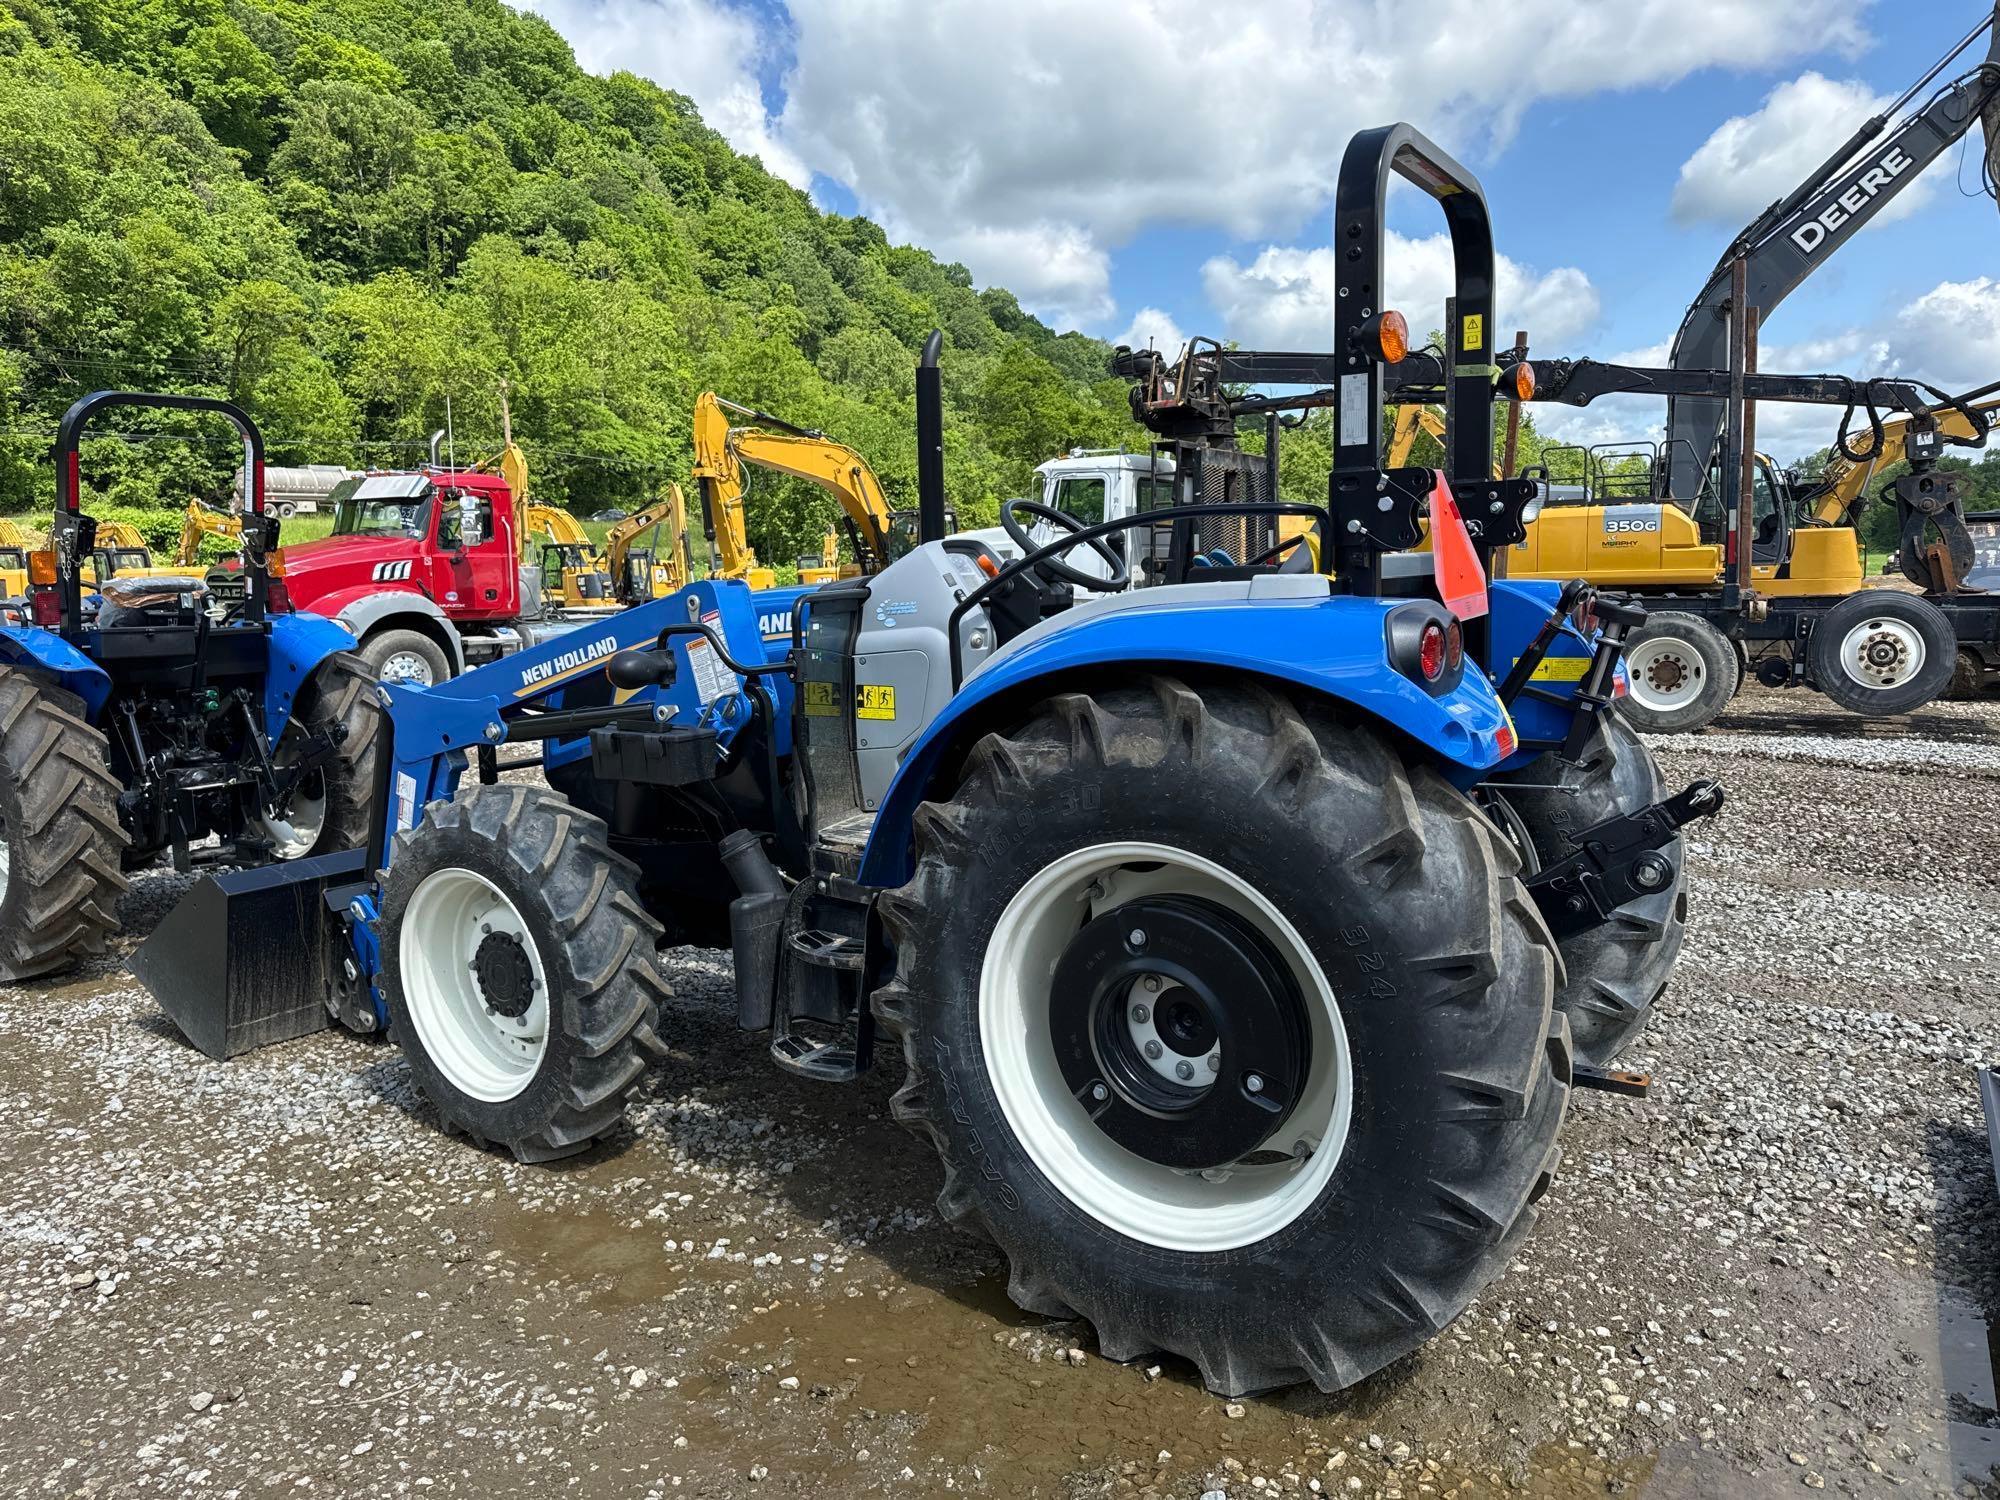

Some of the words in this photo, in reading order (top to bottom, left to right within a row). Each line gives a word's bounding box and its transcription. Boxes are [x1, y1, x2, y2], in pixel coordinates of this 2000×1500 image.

[1791, 146, 1913, 253] DEERE
[1607, 520, 1656, 533] 350G
[521, 660, 553, 686] NEW
[552, 635, 618, 674] HOLLAND
[1340, 925, 1398, 999] 324
